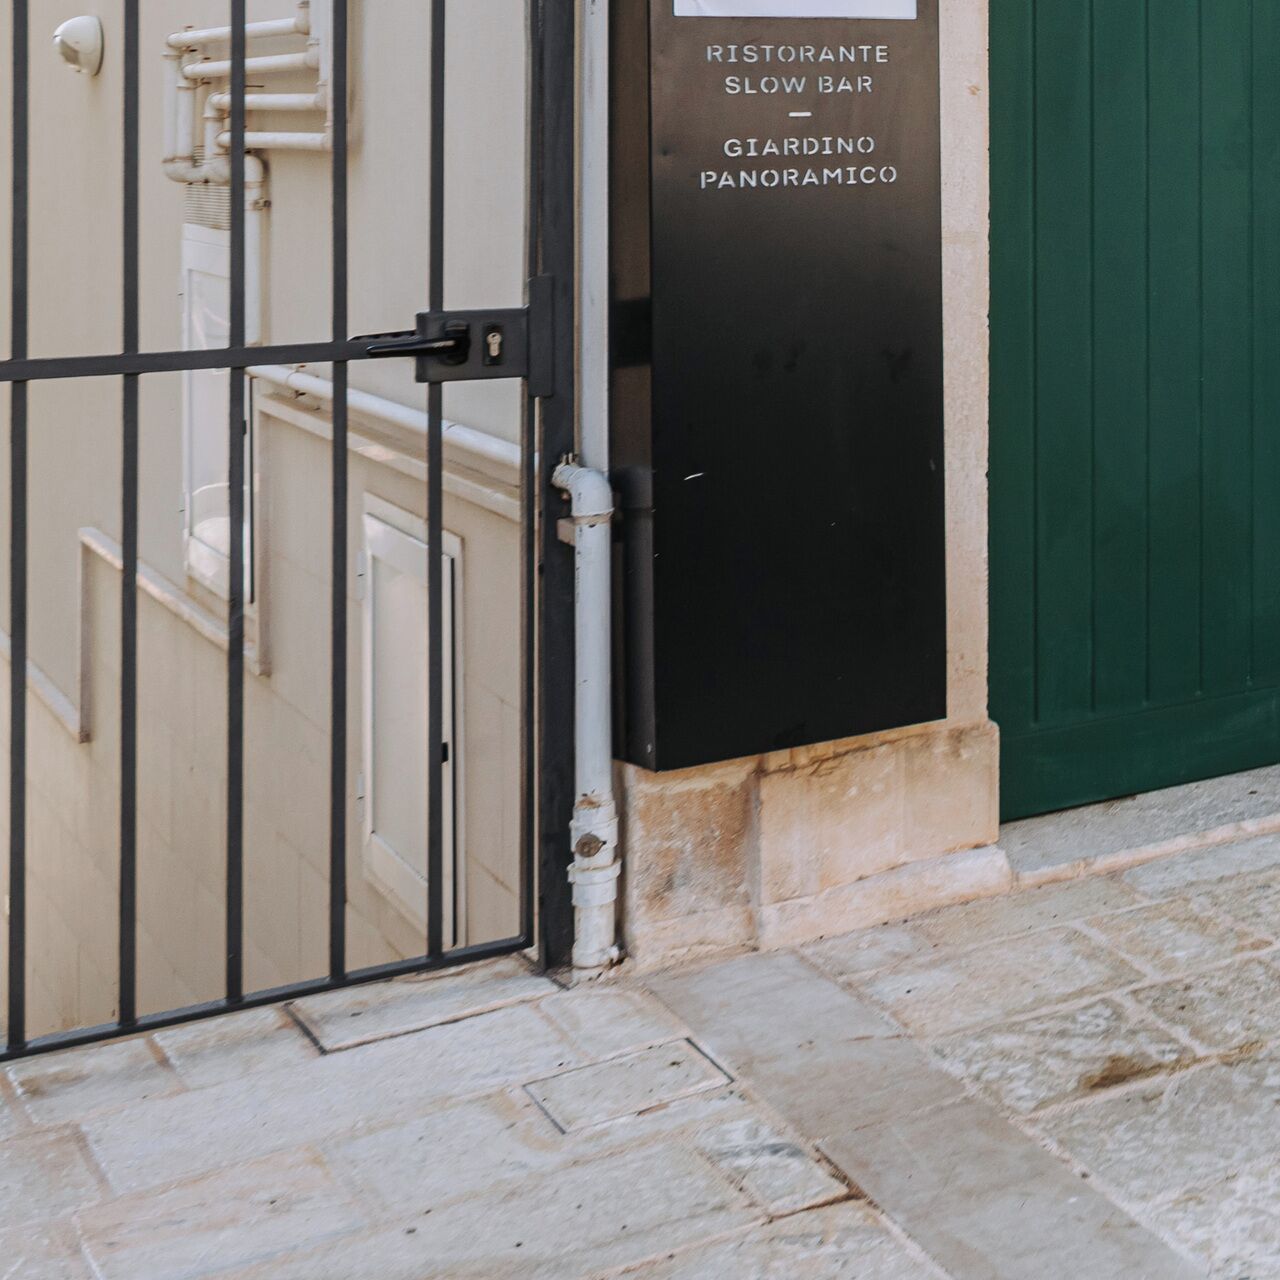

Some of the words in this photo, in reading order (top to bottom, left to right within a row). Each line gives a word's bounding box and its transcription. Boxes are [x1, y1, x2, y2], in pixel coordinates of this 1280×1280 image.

[707, 44, 889, 63] RISTORANTE
[725, 75, 806, 94] SLOW
[817, 75, 873, 93] BAR
[723, 136, 875, 157] GIARDINO
[700, 166, 897, 189] PANORAMICO
